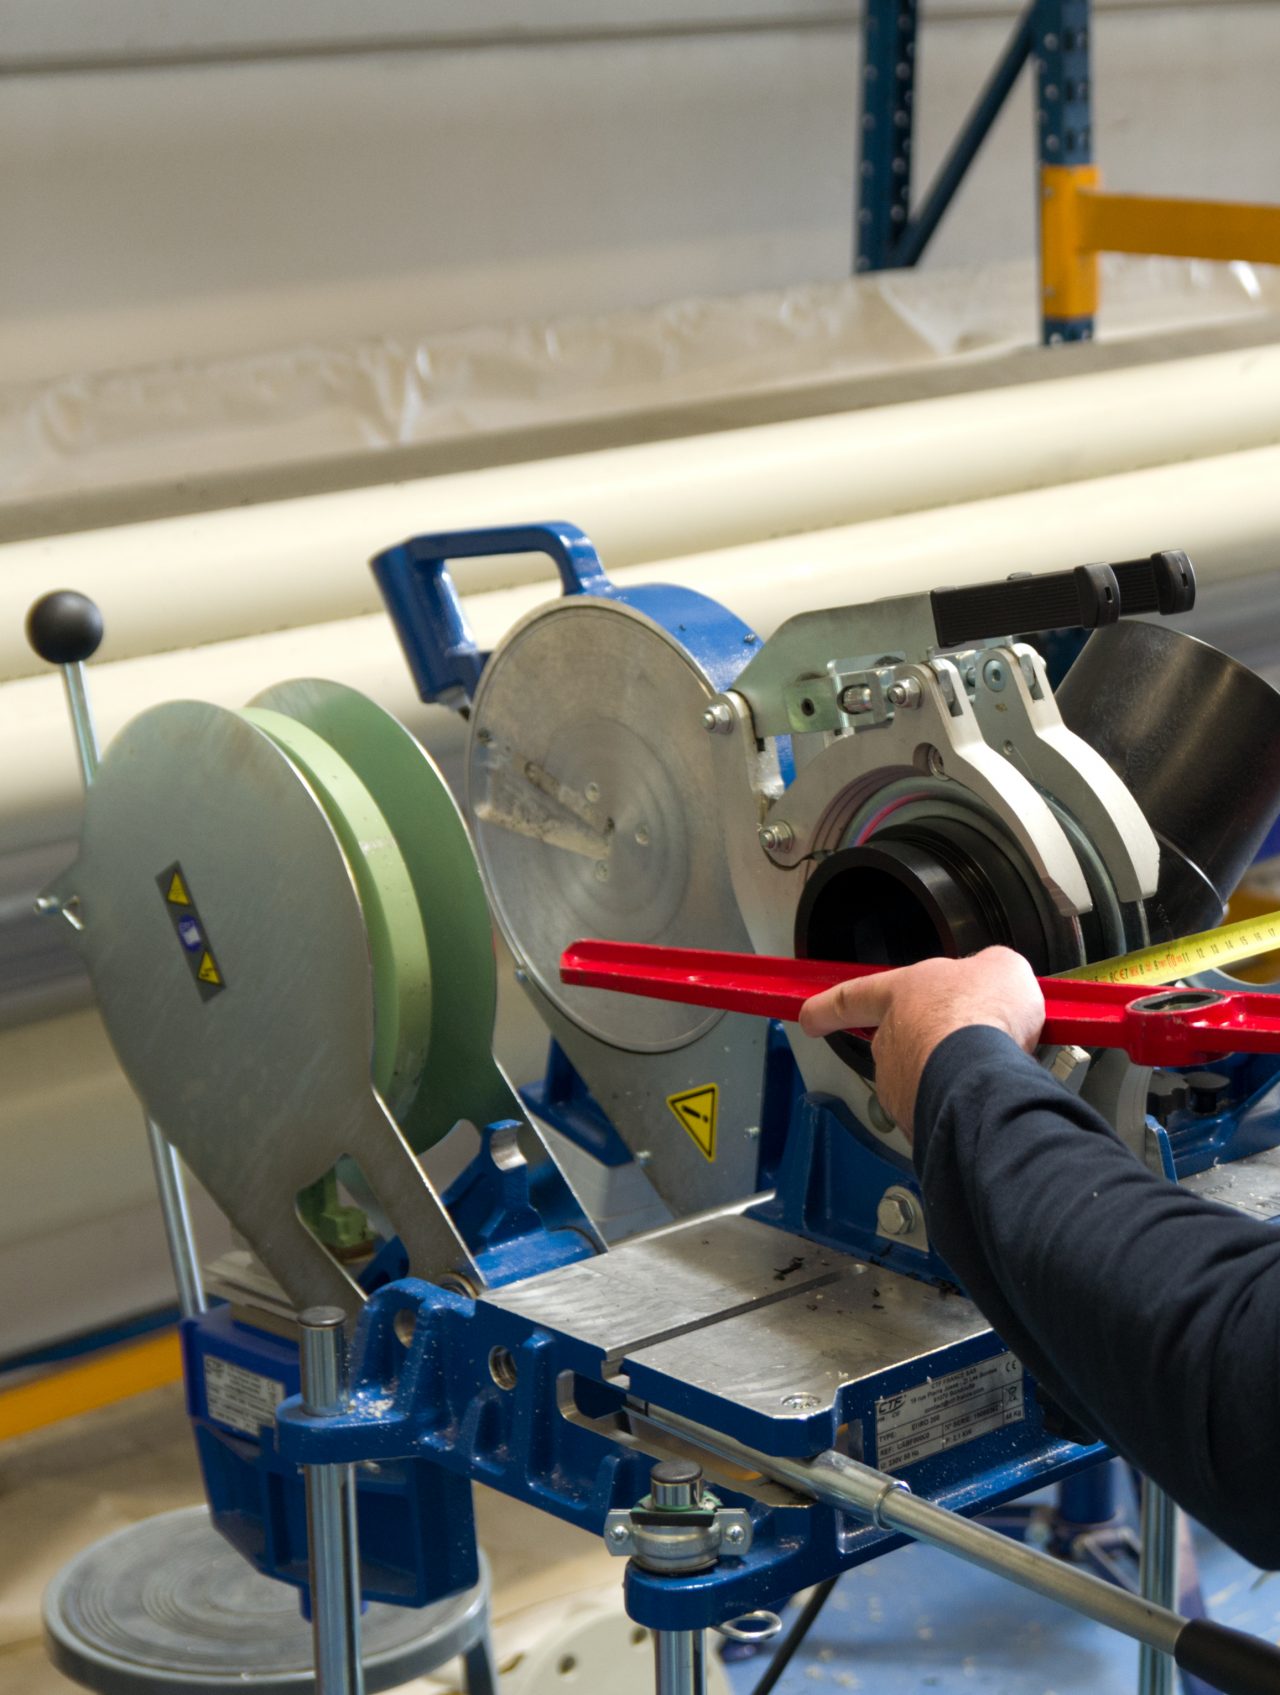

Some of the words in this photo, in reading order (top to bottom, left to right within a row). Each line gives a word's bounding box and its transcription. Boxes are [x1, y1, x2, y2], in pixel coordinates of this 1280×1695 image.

[1166, 953, 1177, 968] 10
[1182, 952, 1190, 962] 11
[1196, 948, 1205, 958] 12
[1211, 944, 1219, 954] 13
[1226, 940, 1234, 950] 14
[1240, 936, 1249, 946] 15
[1268, 928, 1276, 937] 17
[1005, 1360, 1017, 1372] CE
[878, 1395, 904, 1414] CTF
